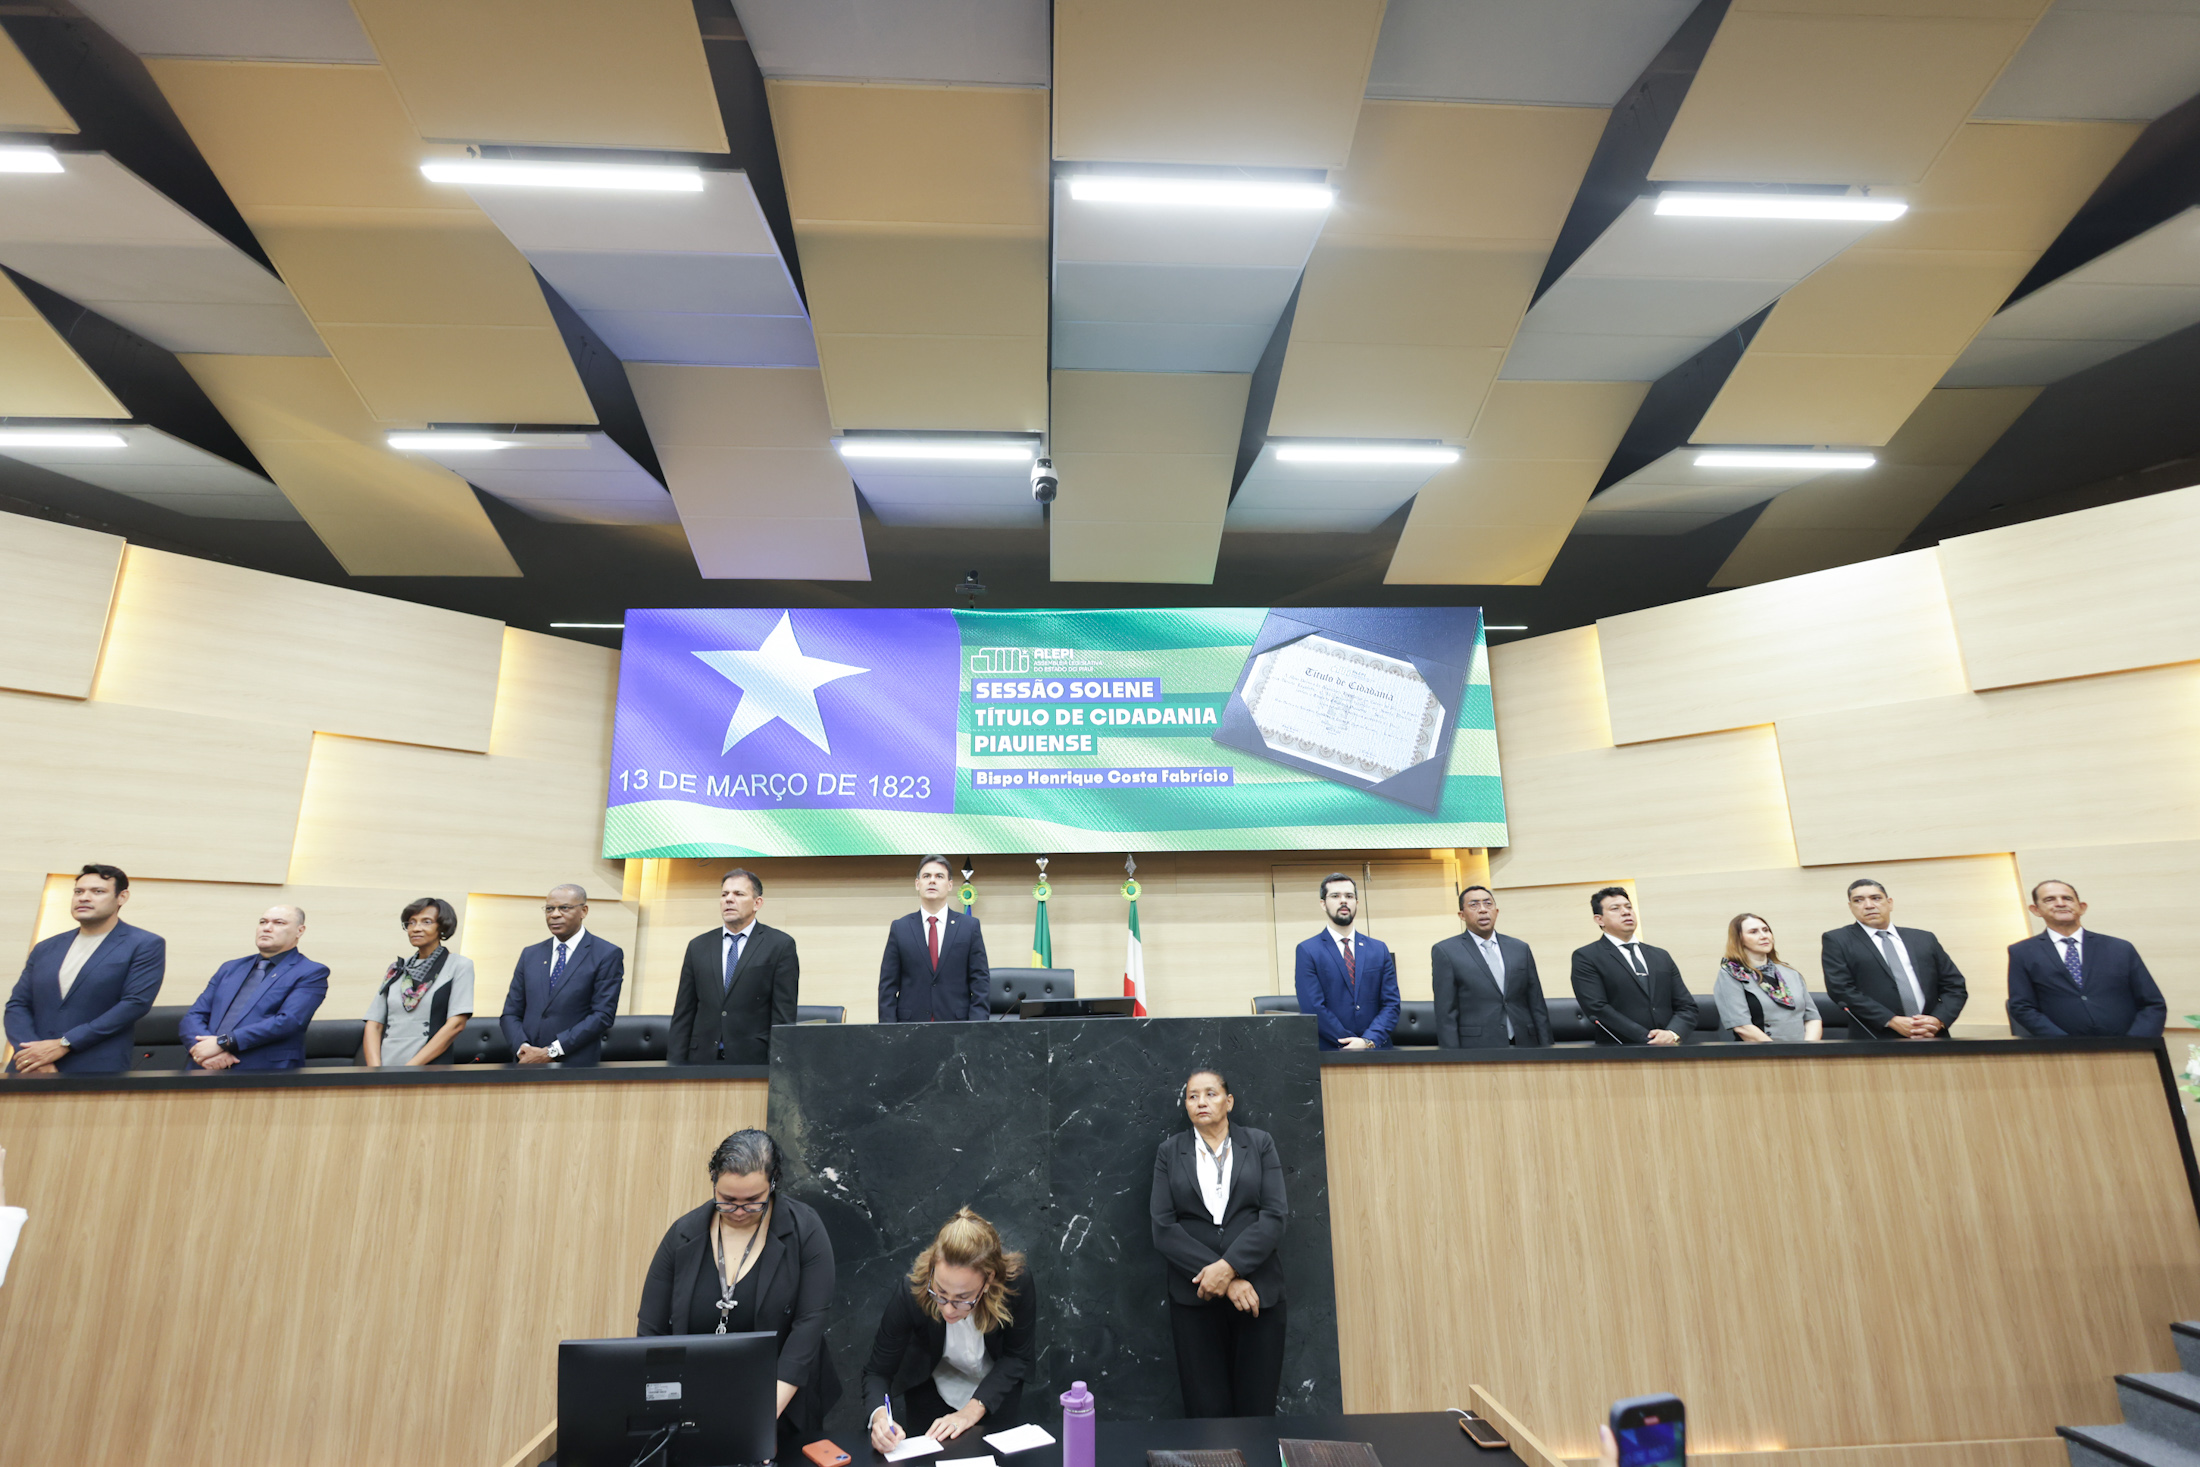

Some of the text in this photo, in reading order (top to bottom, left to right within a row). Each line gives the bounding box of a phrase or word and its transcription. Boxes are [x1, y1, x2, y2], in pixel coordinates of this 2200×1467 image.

[1034, 648, 1074, 659] ALEPI
[975, 679, 1154, 699] SESSÃO SOLENE
[1336, 676, 1346, 687] de
[1348, 681, 1394, 701] Cidadania
[975, 707, 1218, 726] TÍTULO DE CIDADANIA
[974, 735, 1092, 752] PIAUIENSE
[618, 769, 931, 801] 13 DE MARÇO DE 1823
[976, 769, 1229, 787] Bispo Henrique Costa Fabrício
